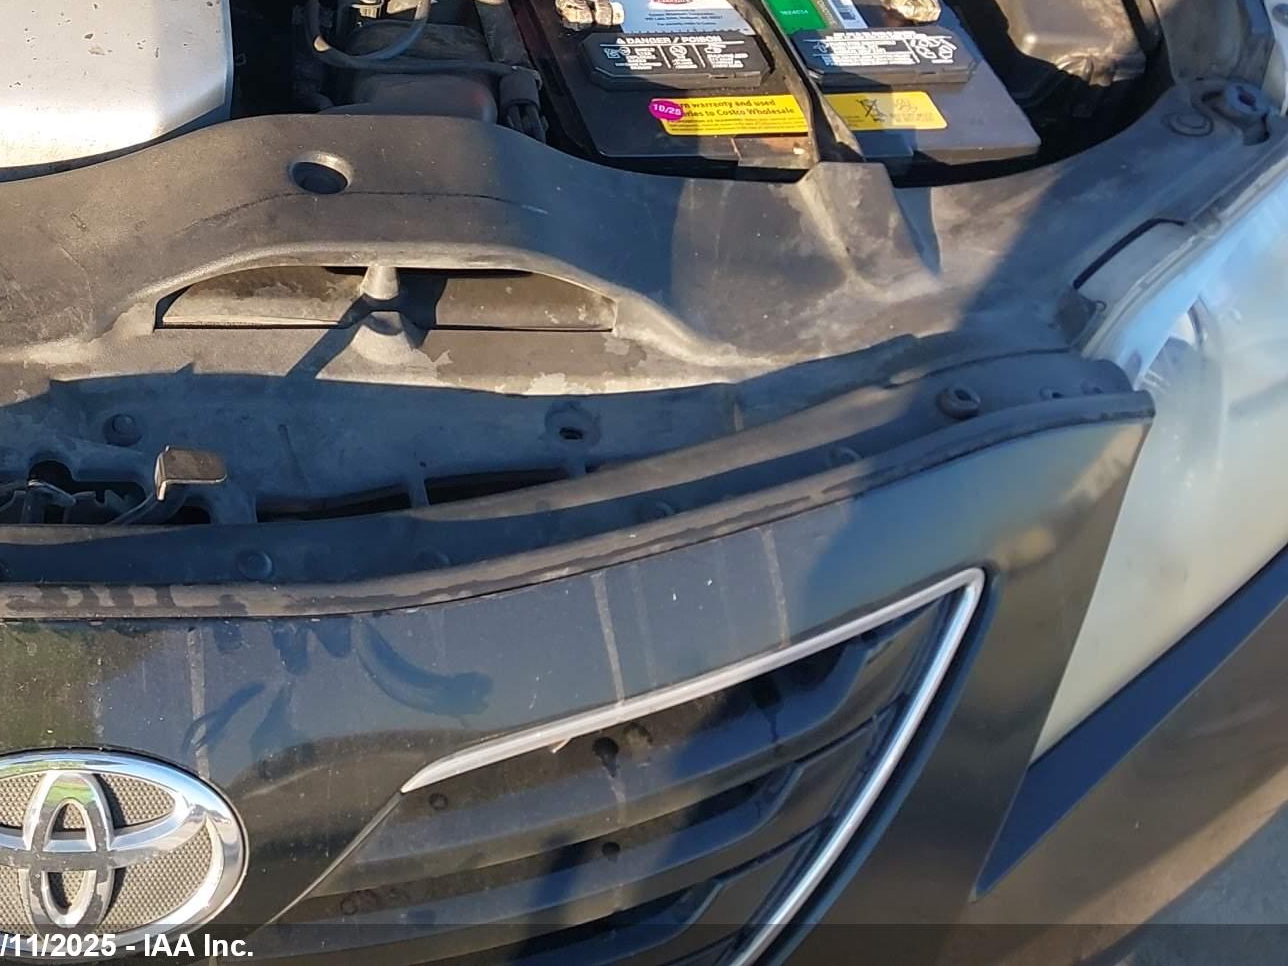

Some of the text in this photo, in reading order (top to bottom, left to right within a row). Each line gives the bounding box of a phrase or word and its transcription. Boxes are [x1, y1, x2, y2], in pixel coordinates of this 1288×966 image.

[625, 36, 672, 45] DANGER
[680, 35, 723, 44] POISON
[692, 101, 733, 109] warranty
[734, 99, 753, 107] and
[755, 98, 776, 107] used
[716, 108, 747, 116] Costco
[748, 106, 795, 116] Wholesale
